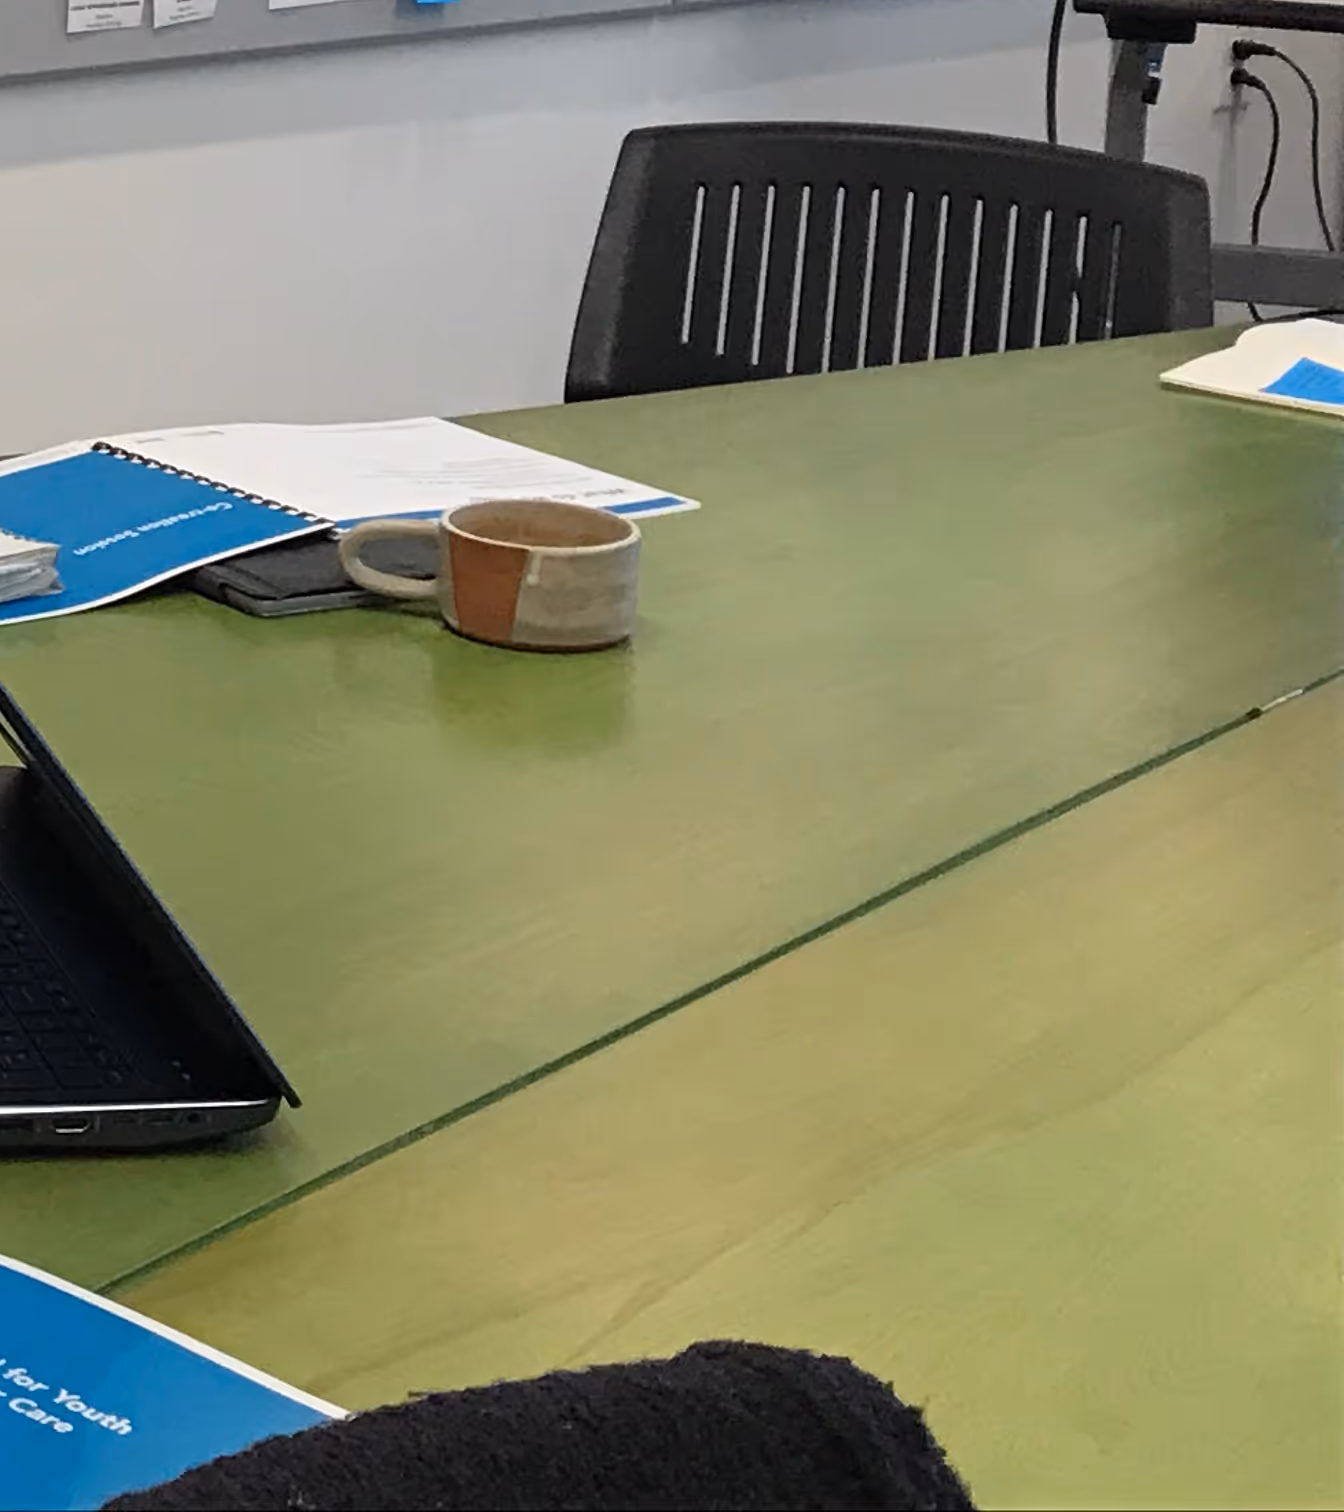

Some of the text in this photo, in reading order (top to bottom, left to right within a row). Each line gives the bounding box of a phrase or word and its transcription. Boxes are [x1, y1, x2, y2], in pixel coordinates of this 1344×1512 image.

[72, 530, 138, 557] Session
[2, 1367, 49, 1393] for
[53, 1388, 133, 1436] Youth
[9, 1397, 74, 1433] Care
